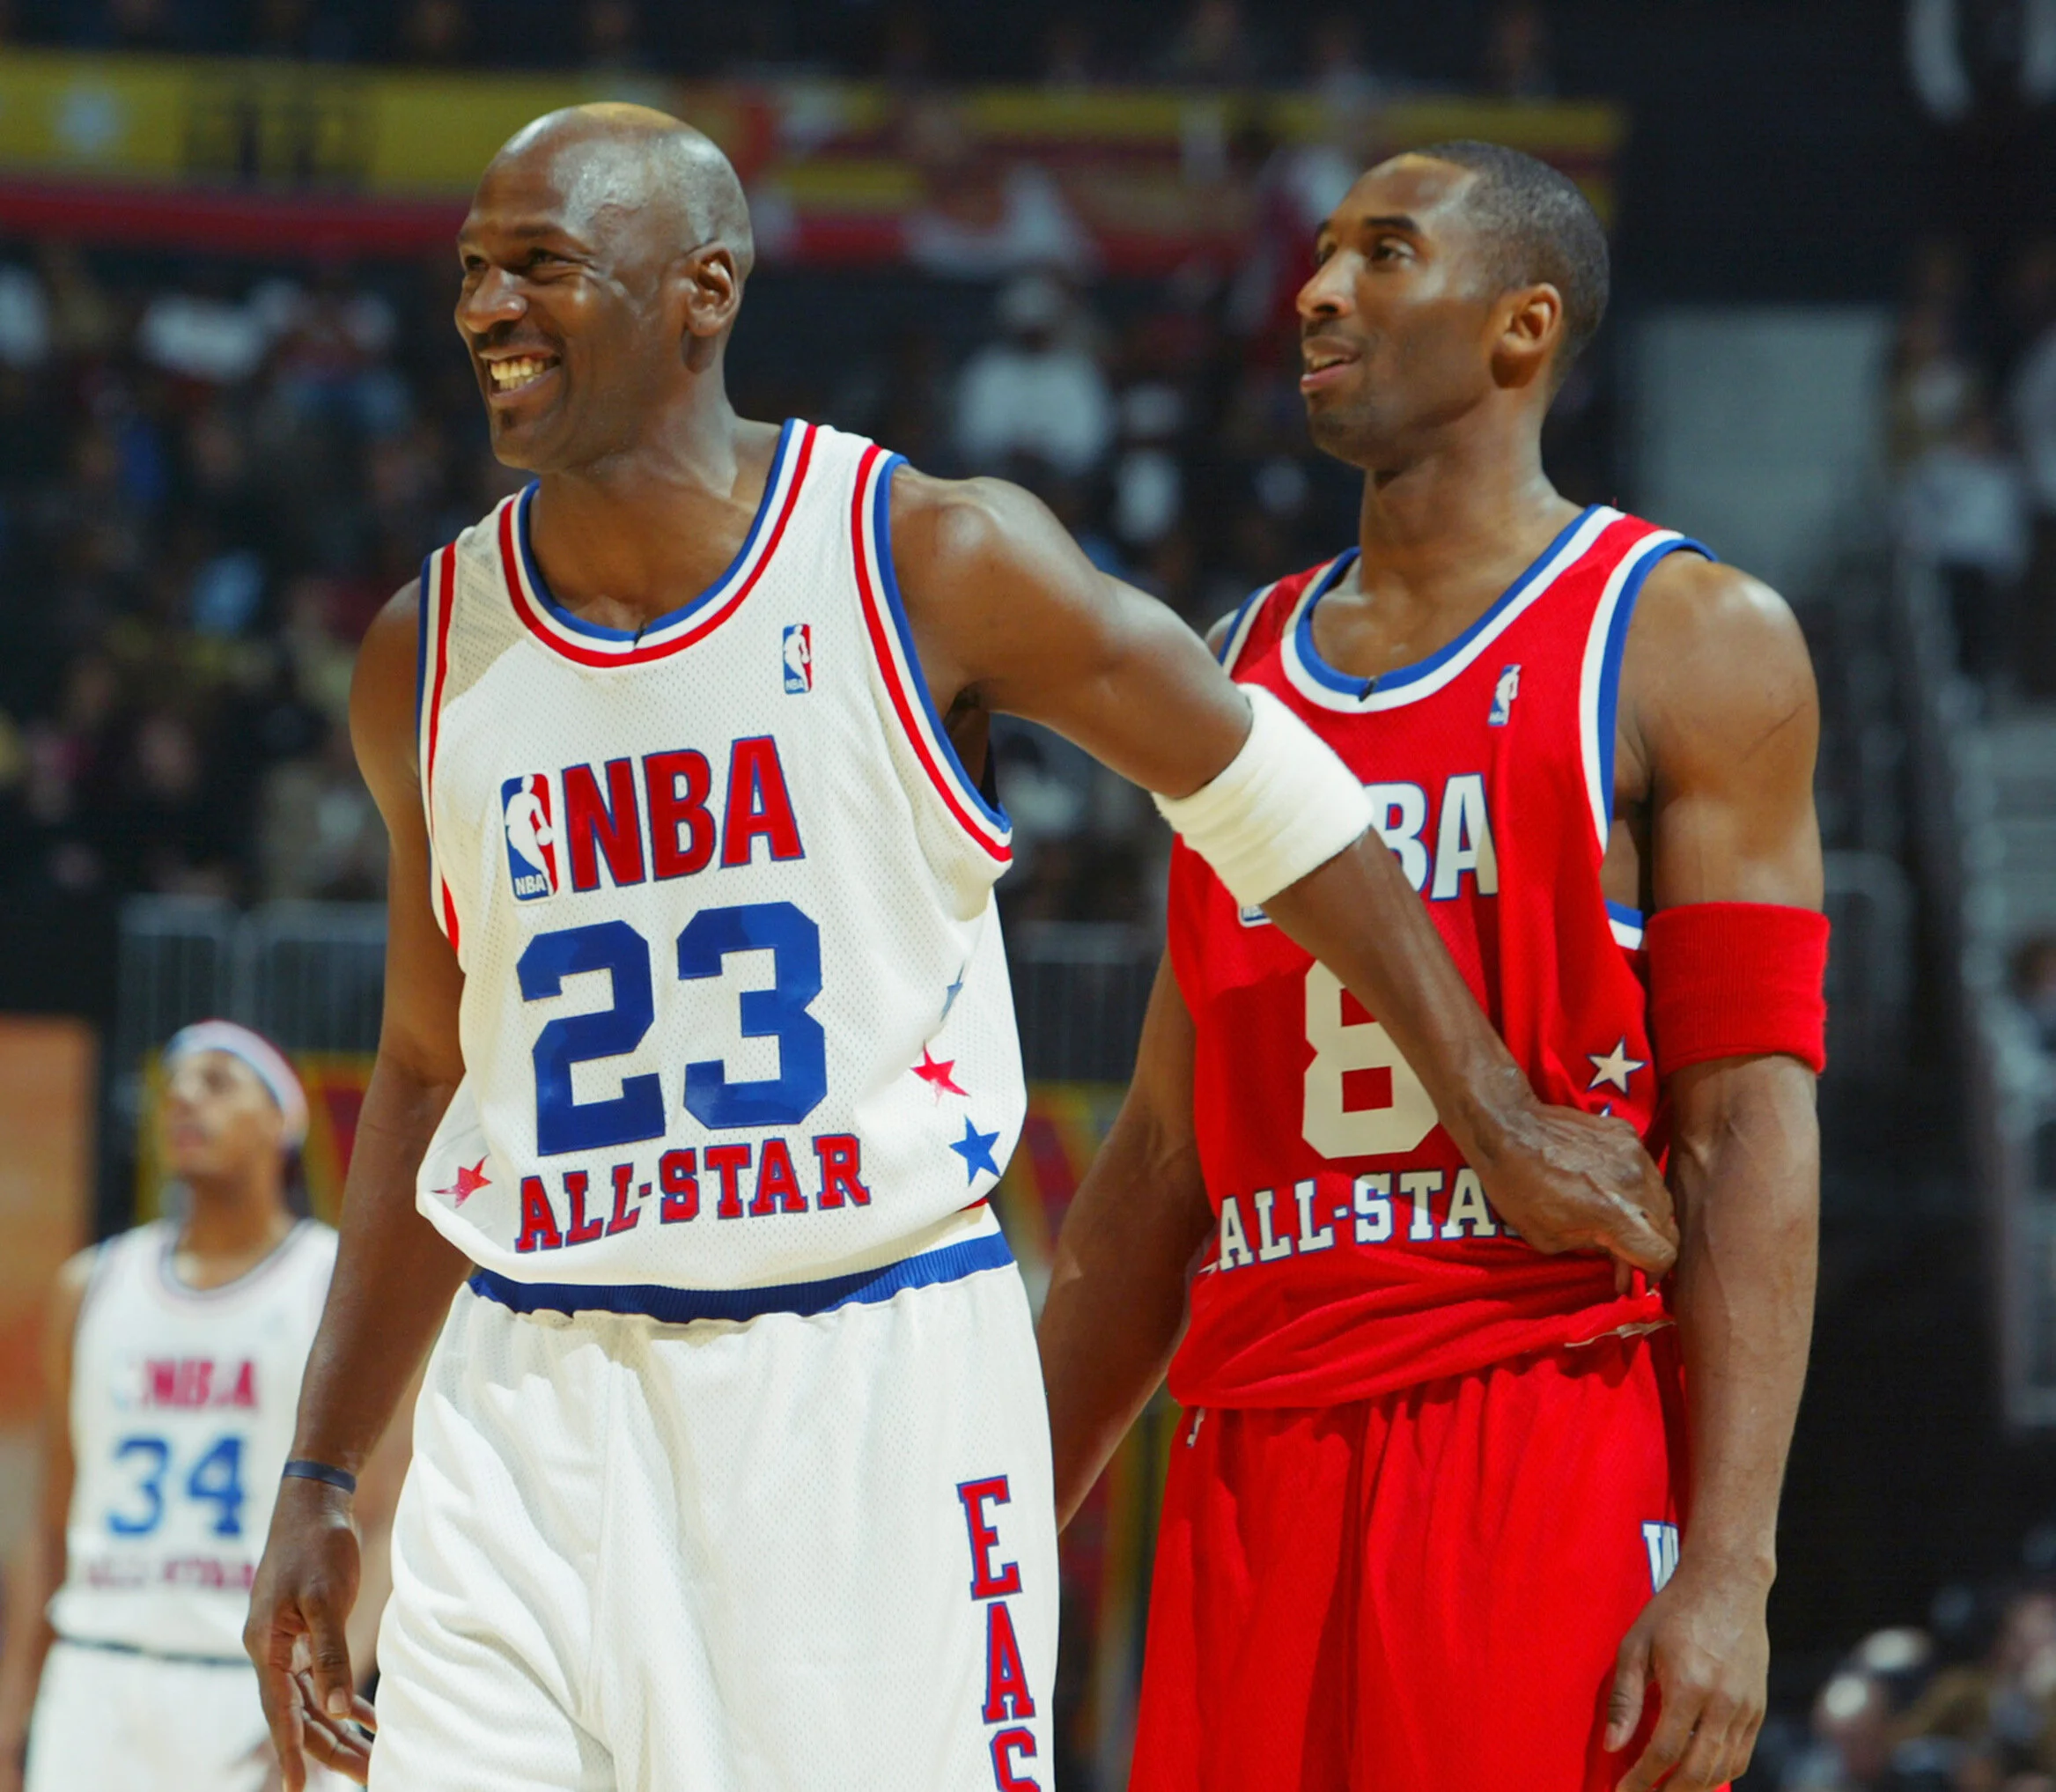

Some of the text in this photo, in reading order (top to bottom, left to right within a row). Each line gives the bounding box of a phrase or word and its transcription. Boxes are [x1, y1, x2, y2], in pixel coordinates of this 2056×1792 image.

[562, 734, 806, 893] NBA
[1363, 771, 1499, 902] BA
[514, 874, 547, 896] NBA
[516, 901, 828, 1157] 23
[1301, 958, 1439, 1160] 8
[515, 1132, 872, 1254] ALL-STAR
[1217, 1168, 1522, 1272] ALL-STA
[106, 1434, 245, 1535] 34
